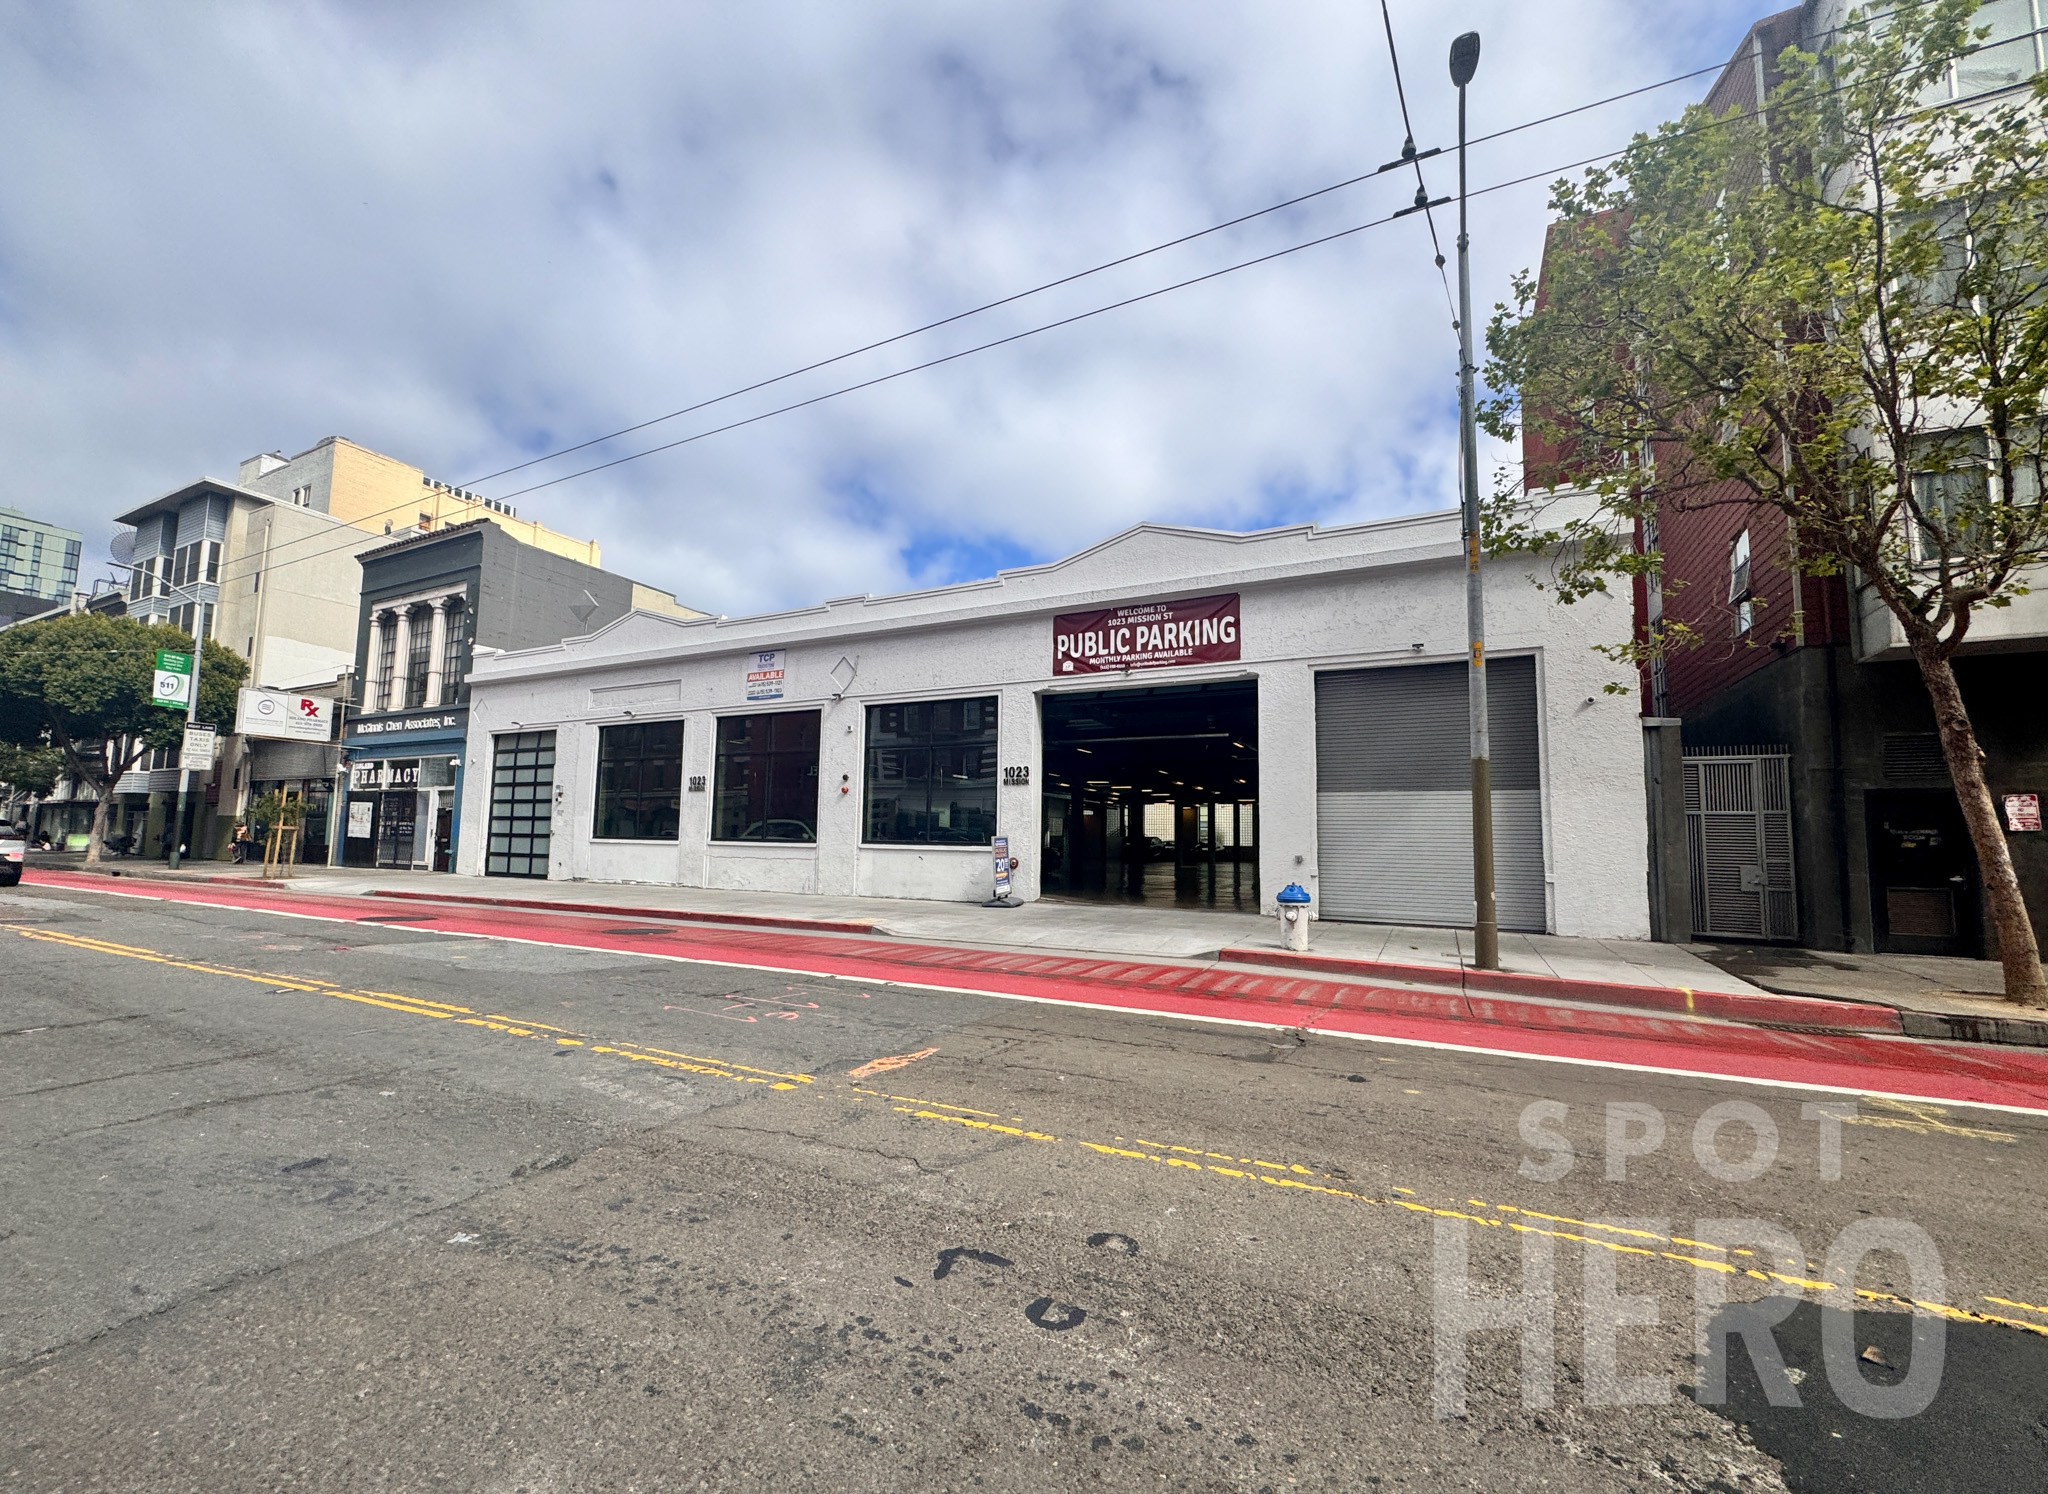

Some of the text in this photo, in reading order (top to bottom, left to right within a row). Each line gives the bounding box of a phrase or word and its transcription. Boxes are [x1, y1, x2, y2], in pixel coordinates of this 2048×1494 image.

[1117, 606, 1155, 617] WELCOME
[1107, 612, 1174, 627] 1023 MISSION ST
[1057, 615, 1236, 660] PUBLIC PARKING
[758, 653, 775, 662] TCP
[1089, 648, 1193, 665] MONTHLY PARKING AVAILABLE
[748, 671, 783, 681] AVAILABLE
[160, 681, 175, 690] 511
[357, 716, 456, 734] McGinnis Chen Associates, Inc.
[1003, 766, 1029, 778] 1023
[689, 776, 705, 786] 1023
[1003, 778, 1029, 786] MISSION
